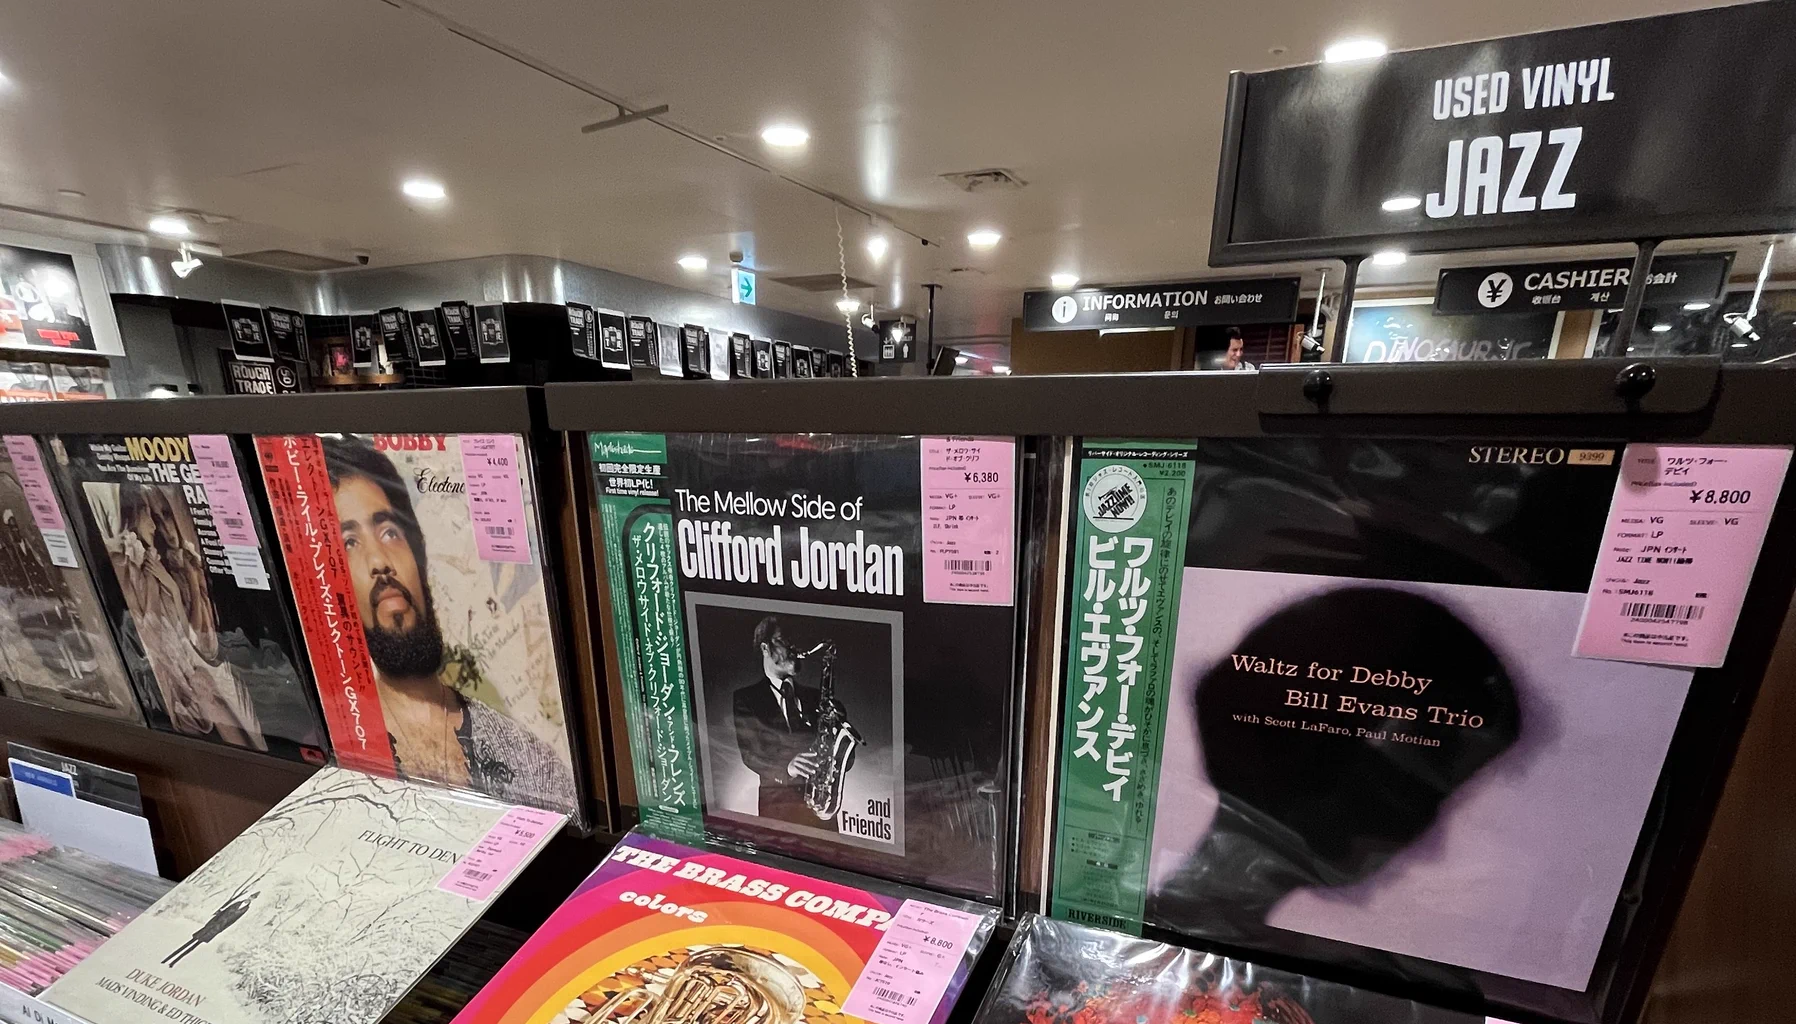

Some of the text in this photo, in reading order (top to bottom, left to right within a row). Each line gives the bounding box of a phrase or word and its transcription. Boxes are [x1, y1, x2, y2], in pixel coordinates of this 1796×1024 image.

[1433, 57, 1615, 120] USED VINYL
[1426, 126, 1583, 218] JAZZ
[1524, 267, 1630, 291] CASHIER
[1082, 290, 1208, 312] INFORMATION
[1214, 293, 1263, 305] お問い合わせ
[233, 363, 270, 380] ROUGH
[236, 379, 274, 394] TRADE
[124, 437, 191, 462] MOODY
[1468, 446, 1565, 465] STEREO
[148, 463, 180, 482] THE
[964, 472, 999, 483] ¥6,380
[675, 489, 863, 521] The Mellow Side of
[1689, 490, 1751, 505] ¥8,800
[1650, 517, 1739, 526] VG VG
[1651, 531, 1664, 539] LP
[678, 518, 904, 596] Clifford Jordan
[1073, 535, 1119, 762] ビル・エヴァンス
[1102, 536, 1153, 802] ワルツ・フォー・デビイ
[1231, 654, 1433, 696] Waltz for Debby
[1284, 689, 1484, 729] Bill Evans Trio
[1232, 713, 1441, 748] with Scott LaFaro, Paul Motian
[867, 798, 891, 818] and
[842, 810, 891, 840] Friends
[357, 829, 411, 850] FLIGHT
[408, 842, 430, 856] TO
[612, 846, 675, 875] THE
[675, 864, 791, 903] BRASS
[619, 891, 709, 924] colors
[1068, 908, 1127, 930] RIVERSIDE
[923, 935, 953, 949] ¥8,800
[95, 977, 125, 994] MADS
[121, 985, 161, 1011] VINDING
[158, 1004, 168, 1015] &
[166, 1007, 183, 1020] ED
[126, 968, 206, 1007] DUKE JORDAN
